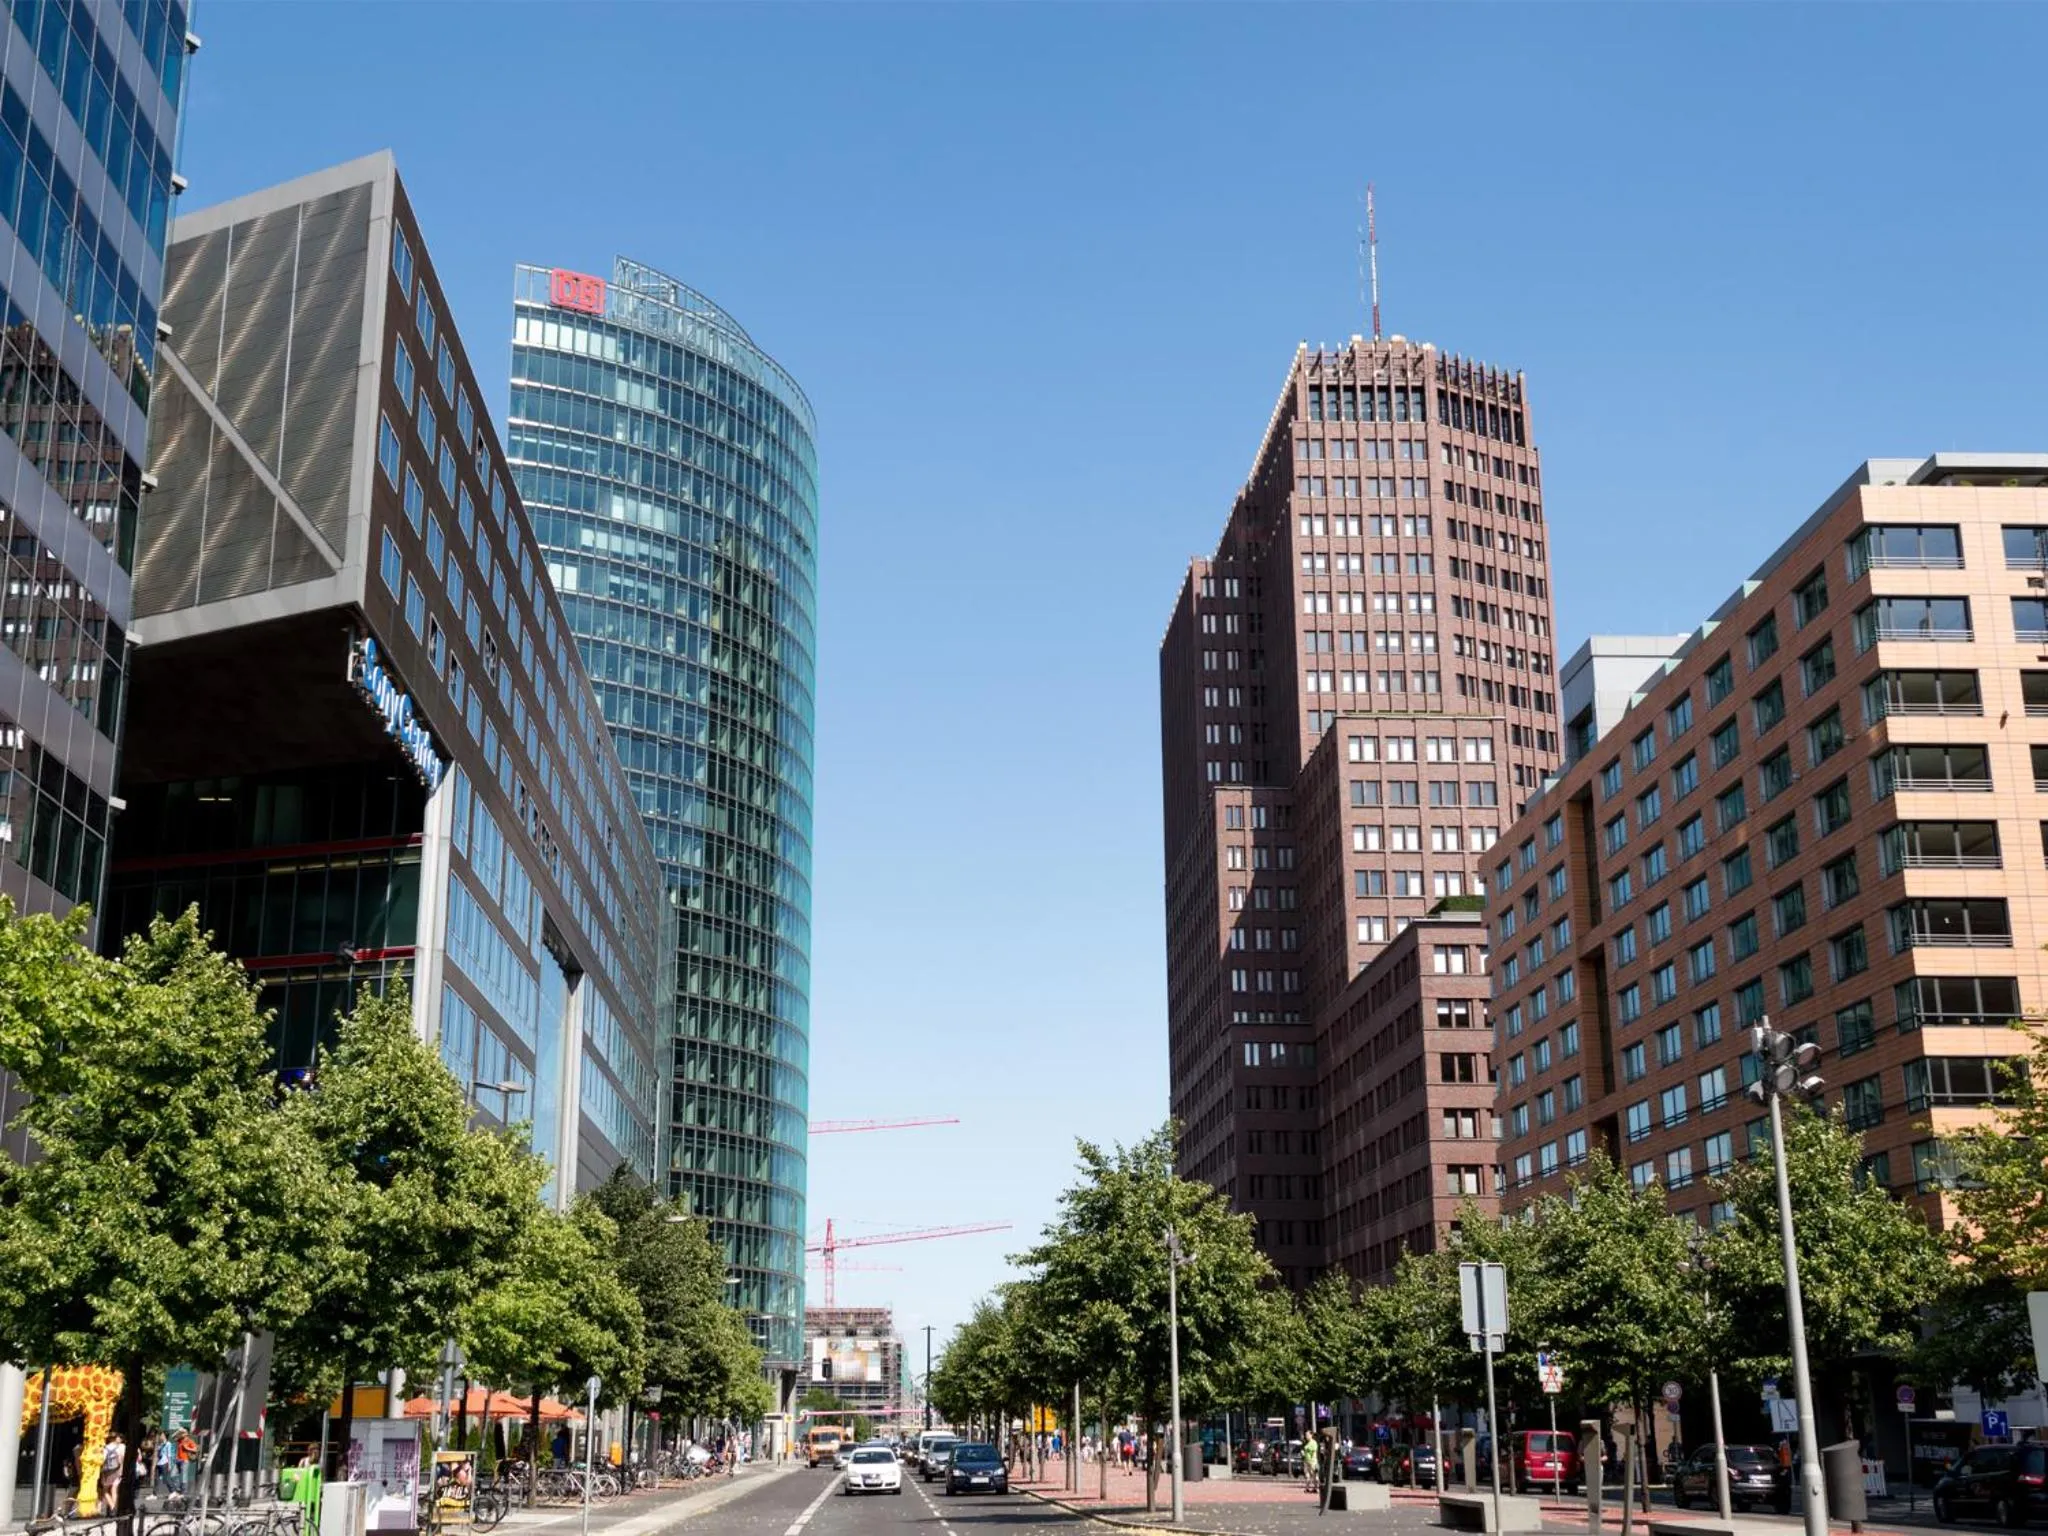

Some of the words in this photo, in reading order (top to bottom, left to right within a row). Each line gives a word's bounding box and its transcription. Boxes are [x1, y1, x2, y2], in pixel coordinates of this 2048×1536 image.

[556, 270, 600, 310] DB
[1988, 1416, 1999, 1430] P
[1999, 1421, 2007, 1436] 1
